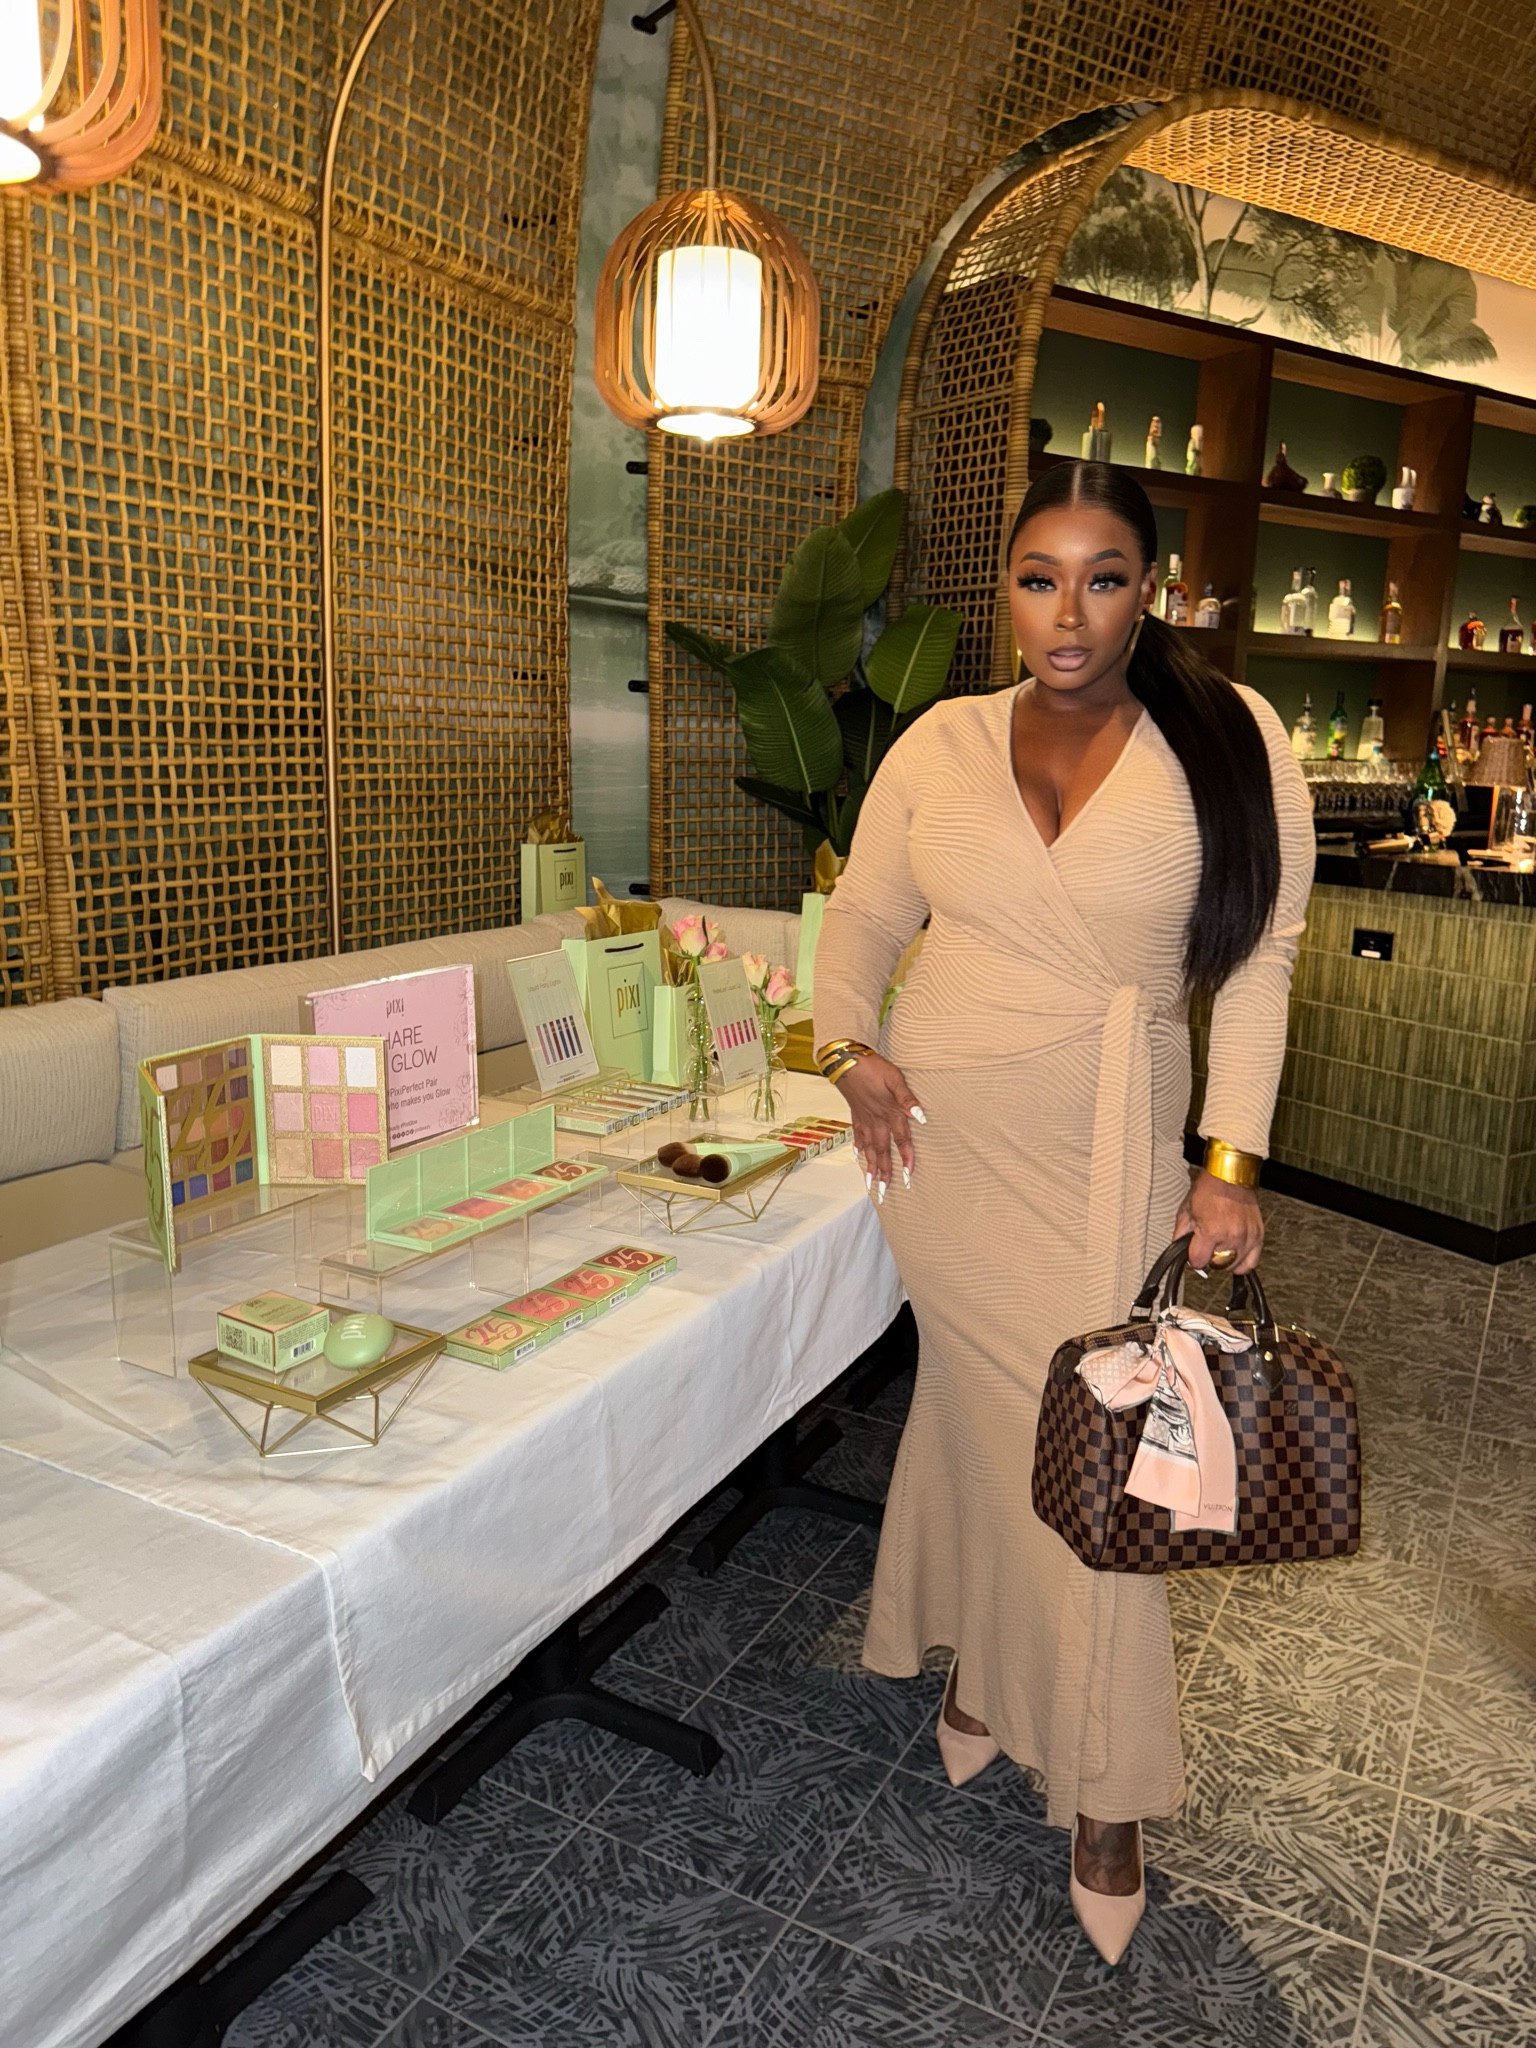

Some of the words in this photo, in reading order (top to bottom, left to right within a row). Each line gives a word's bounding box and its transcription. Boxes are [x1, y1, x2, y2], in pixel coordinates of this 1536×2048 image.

[559, 867, 574, 890] pixi
[386, 998, 404, 1019] pixi
[616, 978, 641, 1018] pixi
[380, 1025, 423, 1050] HARE
[391, 1045, 438, 1073] GLOW
[388, 1081, 425, 1097] PixiPerfect
[425, 1078, 438, 1088] Pair
[388, 1101, 400, 1111] ho
[400, 1096, 422, 1108] makes
[422, 1093, 434, 1104] you
[435, 1088, 451, 1098] Glow
[541, 1160, 588, 1181] 25
[603, 1247, 654, 1269] 25
[563, 1267, 616, 1295] 25
[464, 1315, 524, 1346] 25
